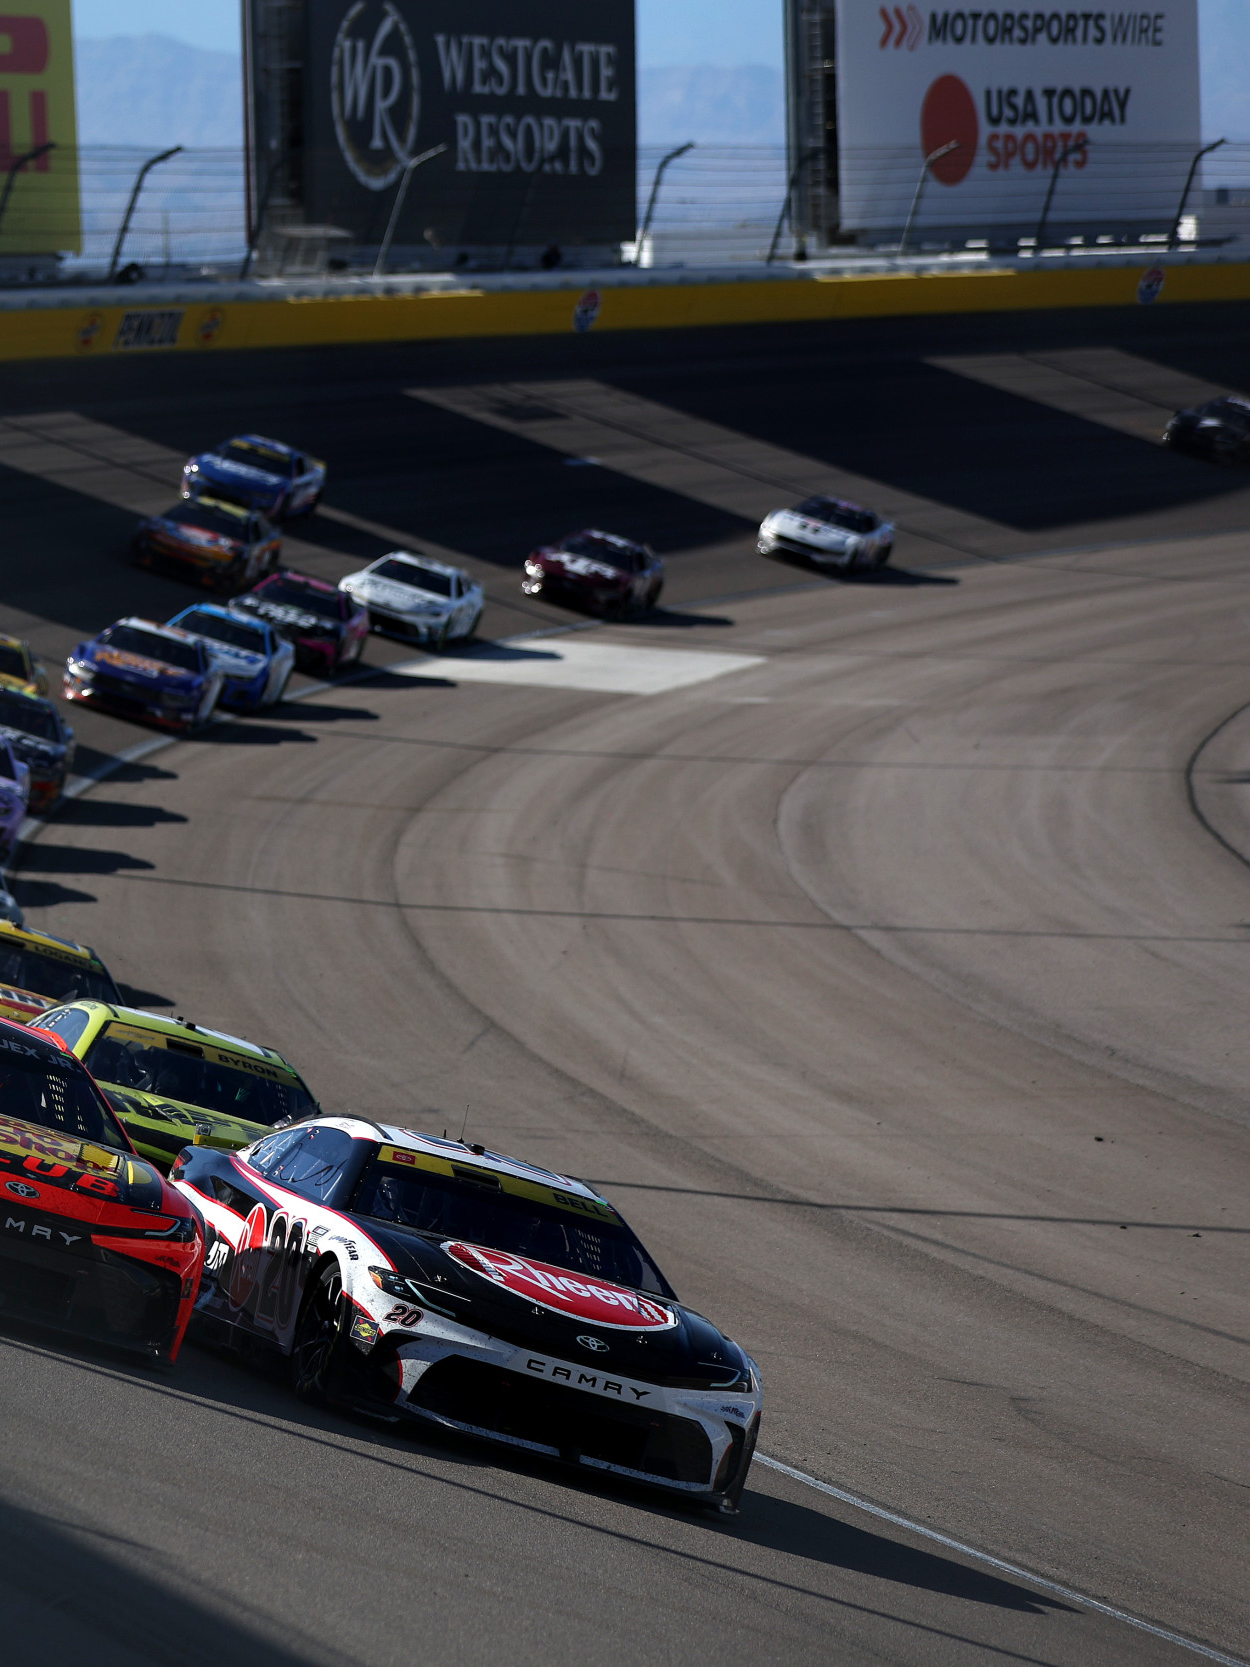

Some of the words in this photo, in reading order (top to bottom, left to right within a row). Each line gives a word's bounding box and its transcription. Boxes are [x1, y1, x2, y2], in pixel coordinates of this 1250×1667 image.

[927, 12, 1106, 45] MOTORSPORTS
[1109, 13, 1165, 46] WIRE
[434, 33, 619, 102] WESTGATE
[984, 87, 1040, 126] USA
[1042, 86, 1130, 126] TODAY
[454, 113, 604, 176] RESORTS
[987, 131, 1088, 171] SPORTS
[218, 1053, 278, 1078] BYRON
[553, 1193, 608, 1218] BELL
[462, 1243, 660, 1322] Rheem
[382, 1303, 424, 1328] 20
[526, 1358, 651, 1400] CAMRY
